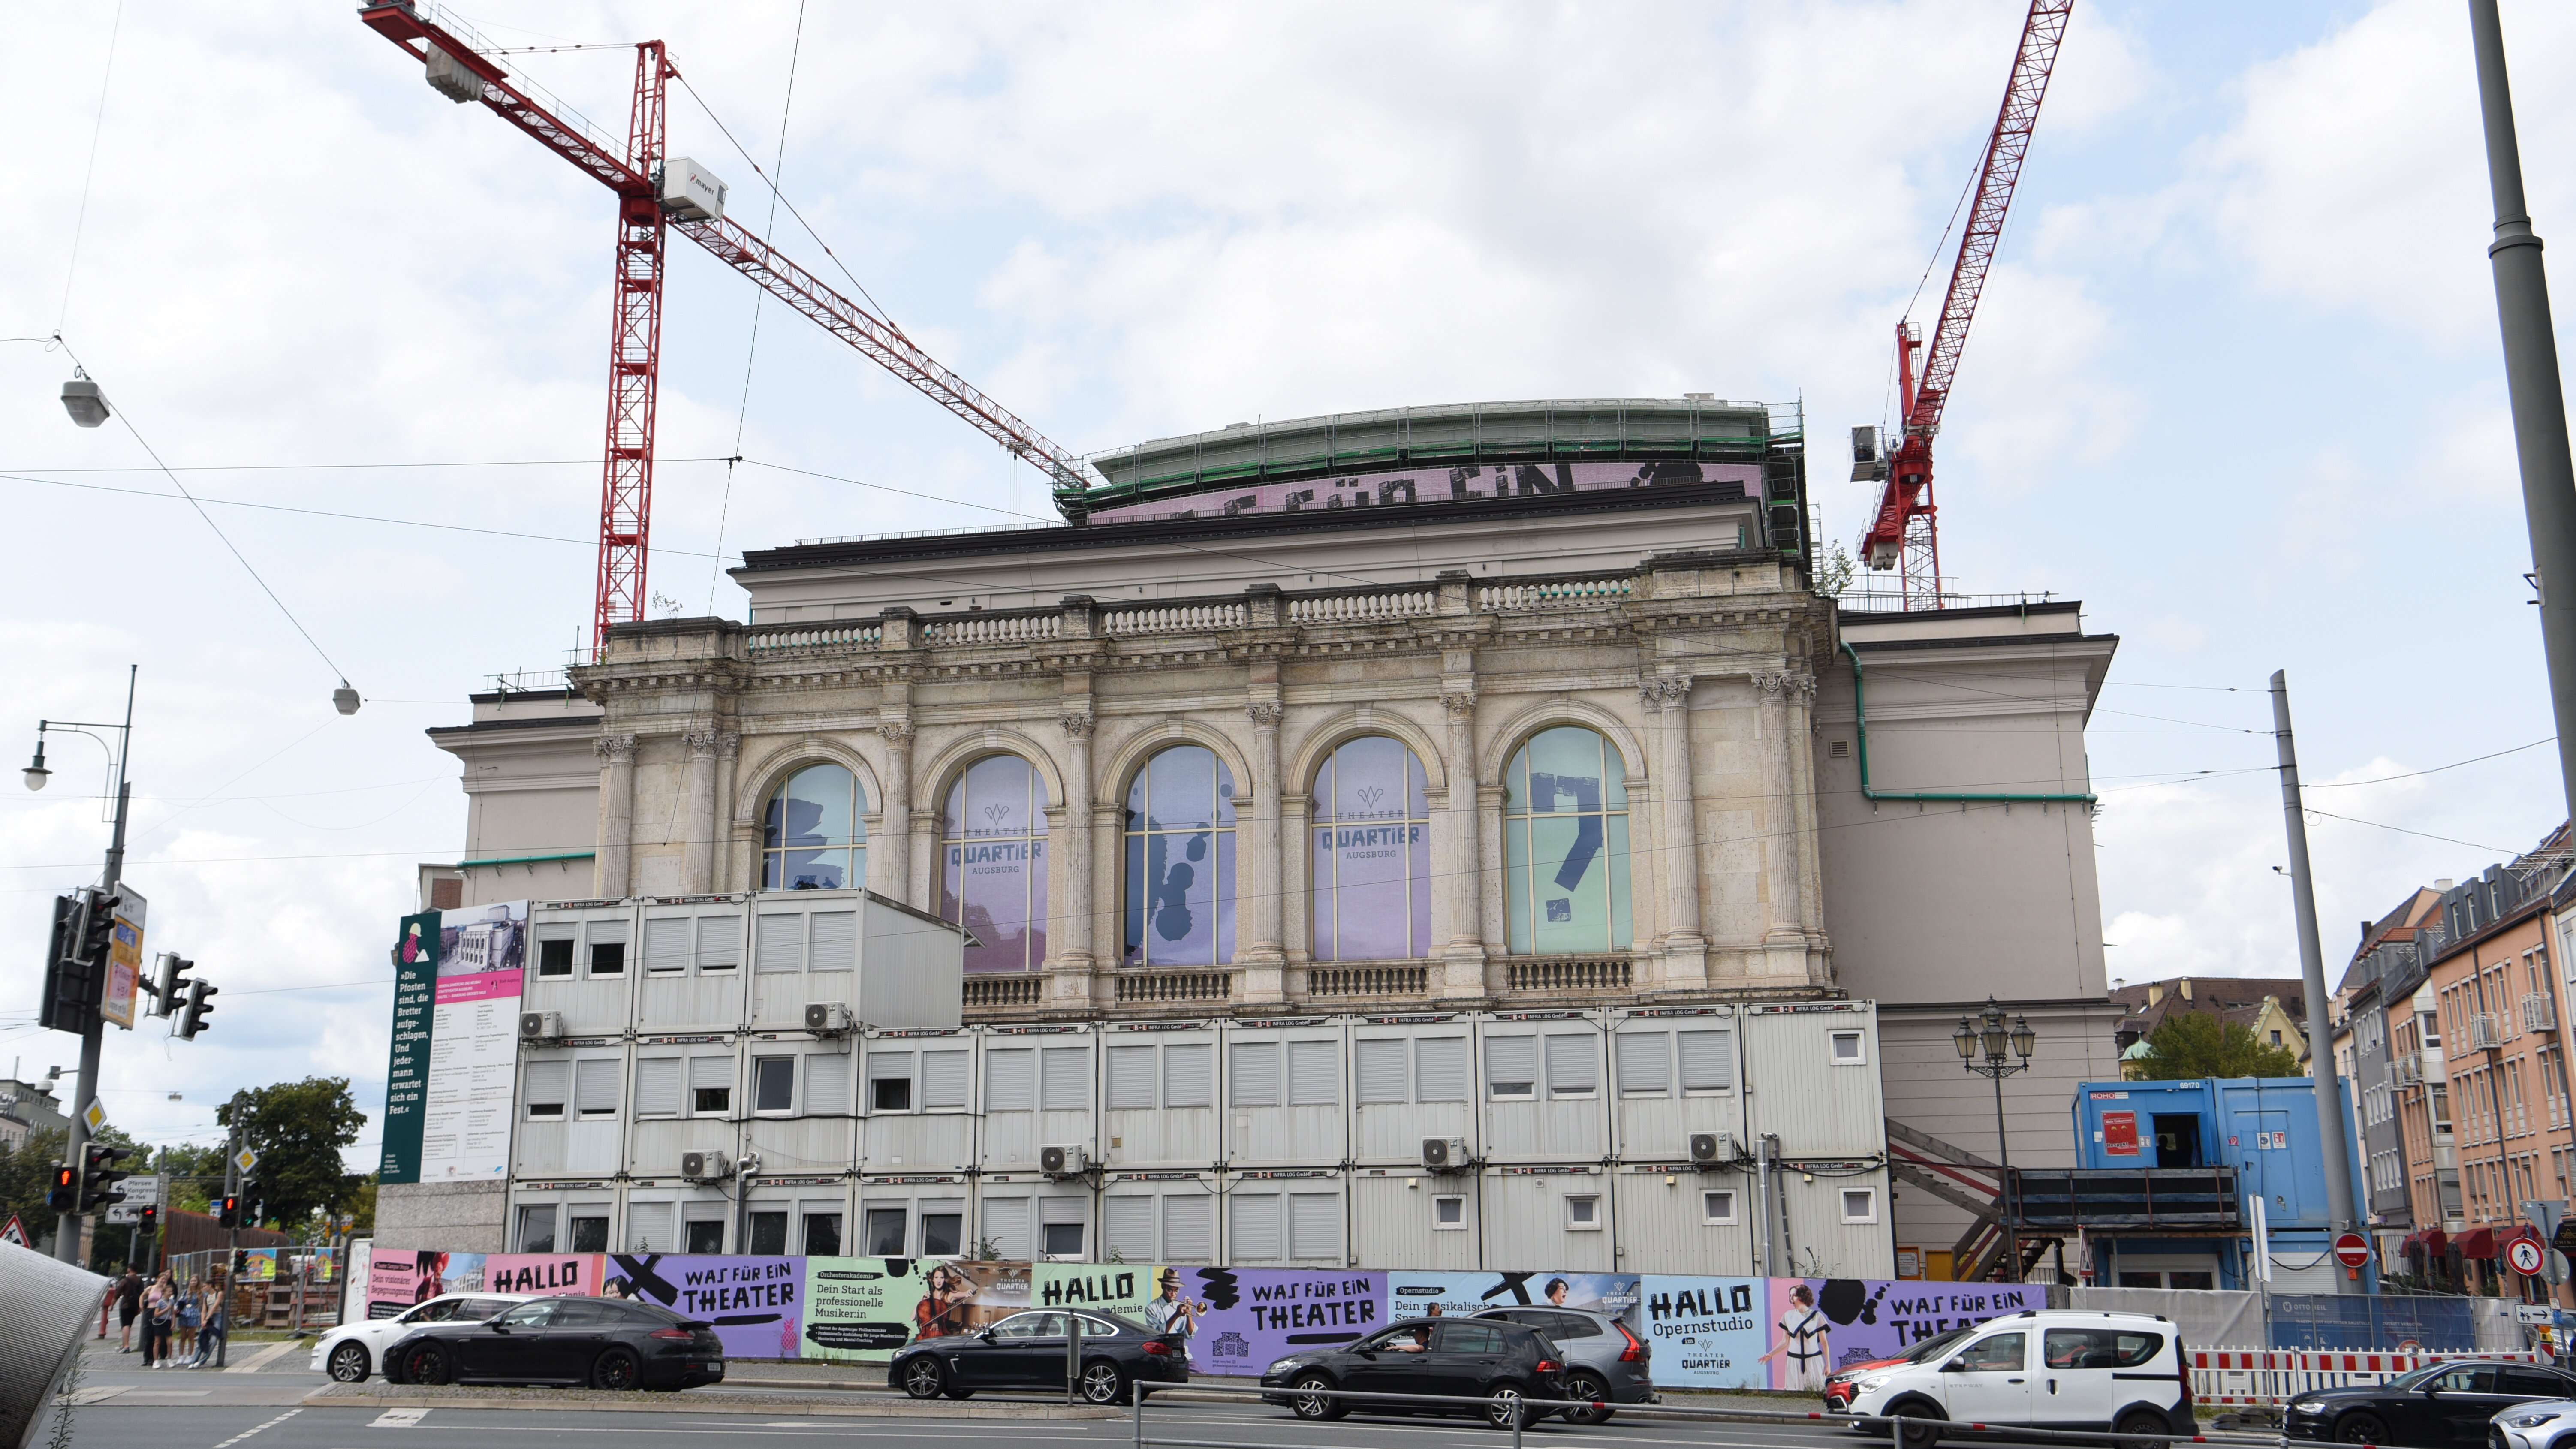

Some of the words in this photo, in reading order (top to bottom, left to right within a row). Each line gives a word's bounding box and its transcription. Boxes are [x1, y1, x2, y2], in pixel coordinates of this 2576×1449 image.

[696, 178, 714, 196] mayer
[1338, 810, 1404, 819] THEATER
[965, 827, 1027, 837] THEATER
[1346, 850, 1396, 859] AUGSBURG
[972, 866, 1019, 874] AUGSBURG
[399, 982, 426, 993] Pfosten
[398, 994, 416, 1004] sind,
[417, 993, 429, 1003] die
[397, 1007, 422, 1017] Bretter
[396, 1019, 419, 1030] aufge-
[395, 1031, 429, 1041] schlagen,
[395, 1043, 410, 1053] Und
[393, 1055, 414, 1067] jeder-
[392, 1069, 413, 1078] mann
[391, 1079, 422, 1090] erwartet
[390, 1092, 405, 1102] sich
[406, 1092, 418, 1101] ein
[372, 1274, 383, 1283] Dein
[494, 1261, 578, 1293] HALLO
[732, 1265, 760, 1281] FÜR
[817, 1284, 839, 1293] Dein
[841, 1285, 865, 1295] Start
[868, 1286, 883, 1295] als
[1041, 1272, 1134, 1306] HALLO
[1305, 1280, 1336, 1298] FÜR
[682, 1282, 794, 1313] THEATER
[816, 1296, 883, 1307] professionelle
[1648, 1284, 1752, 1320] HALLO
[1950, 1294, 1985, 1311] FÜR
[1395, 1301, 1419, 1310] Dein
[815, 1308, 867, 1319] Musiker:in
[1250, 1299, 1374, 1331] THEATER
[1653, 1316, 1753, 1338] Opernstudio
